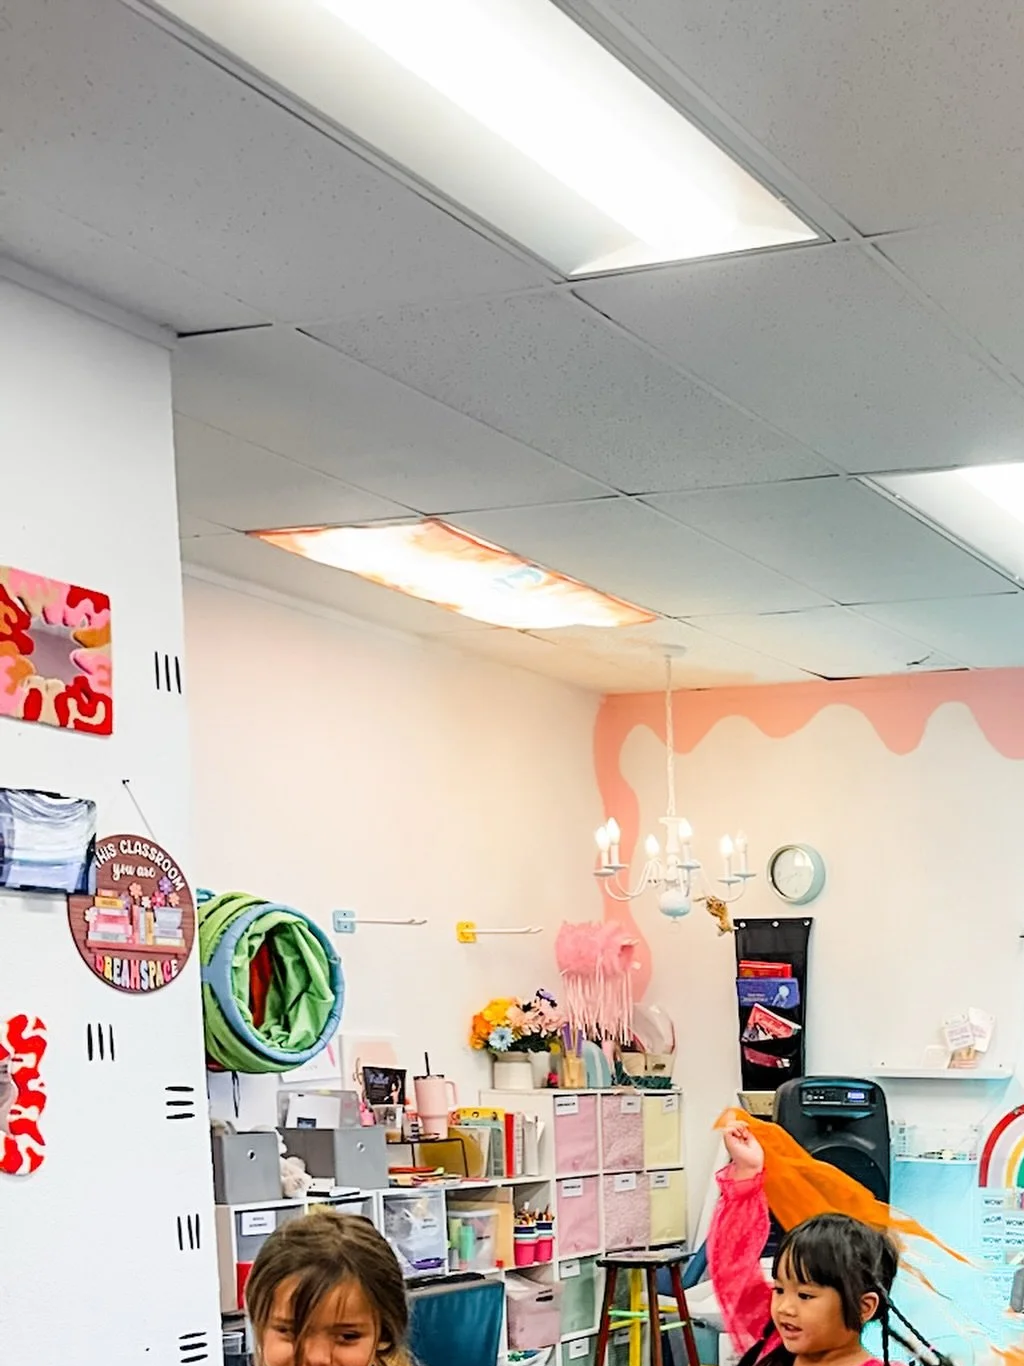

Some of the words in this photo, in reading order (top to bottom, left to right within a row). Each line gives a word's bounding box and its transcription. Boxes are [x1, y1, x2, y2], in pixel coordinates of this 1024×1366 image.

[112, 862, 136, 881] you
[136, 866, 156, 879] are
[119, 839, 186, 892] CLASSROOM
[95, 955, 179, 991] DREAMSPACE
